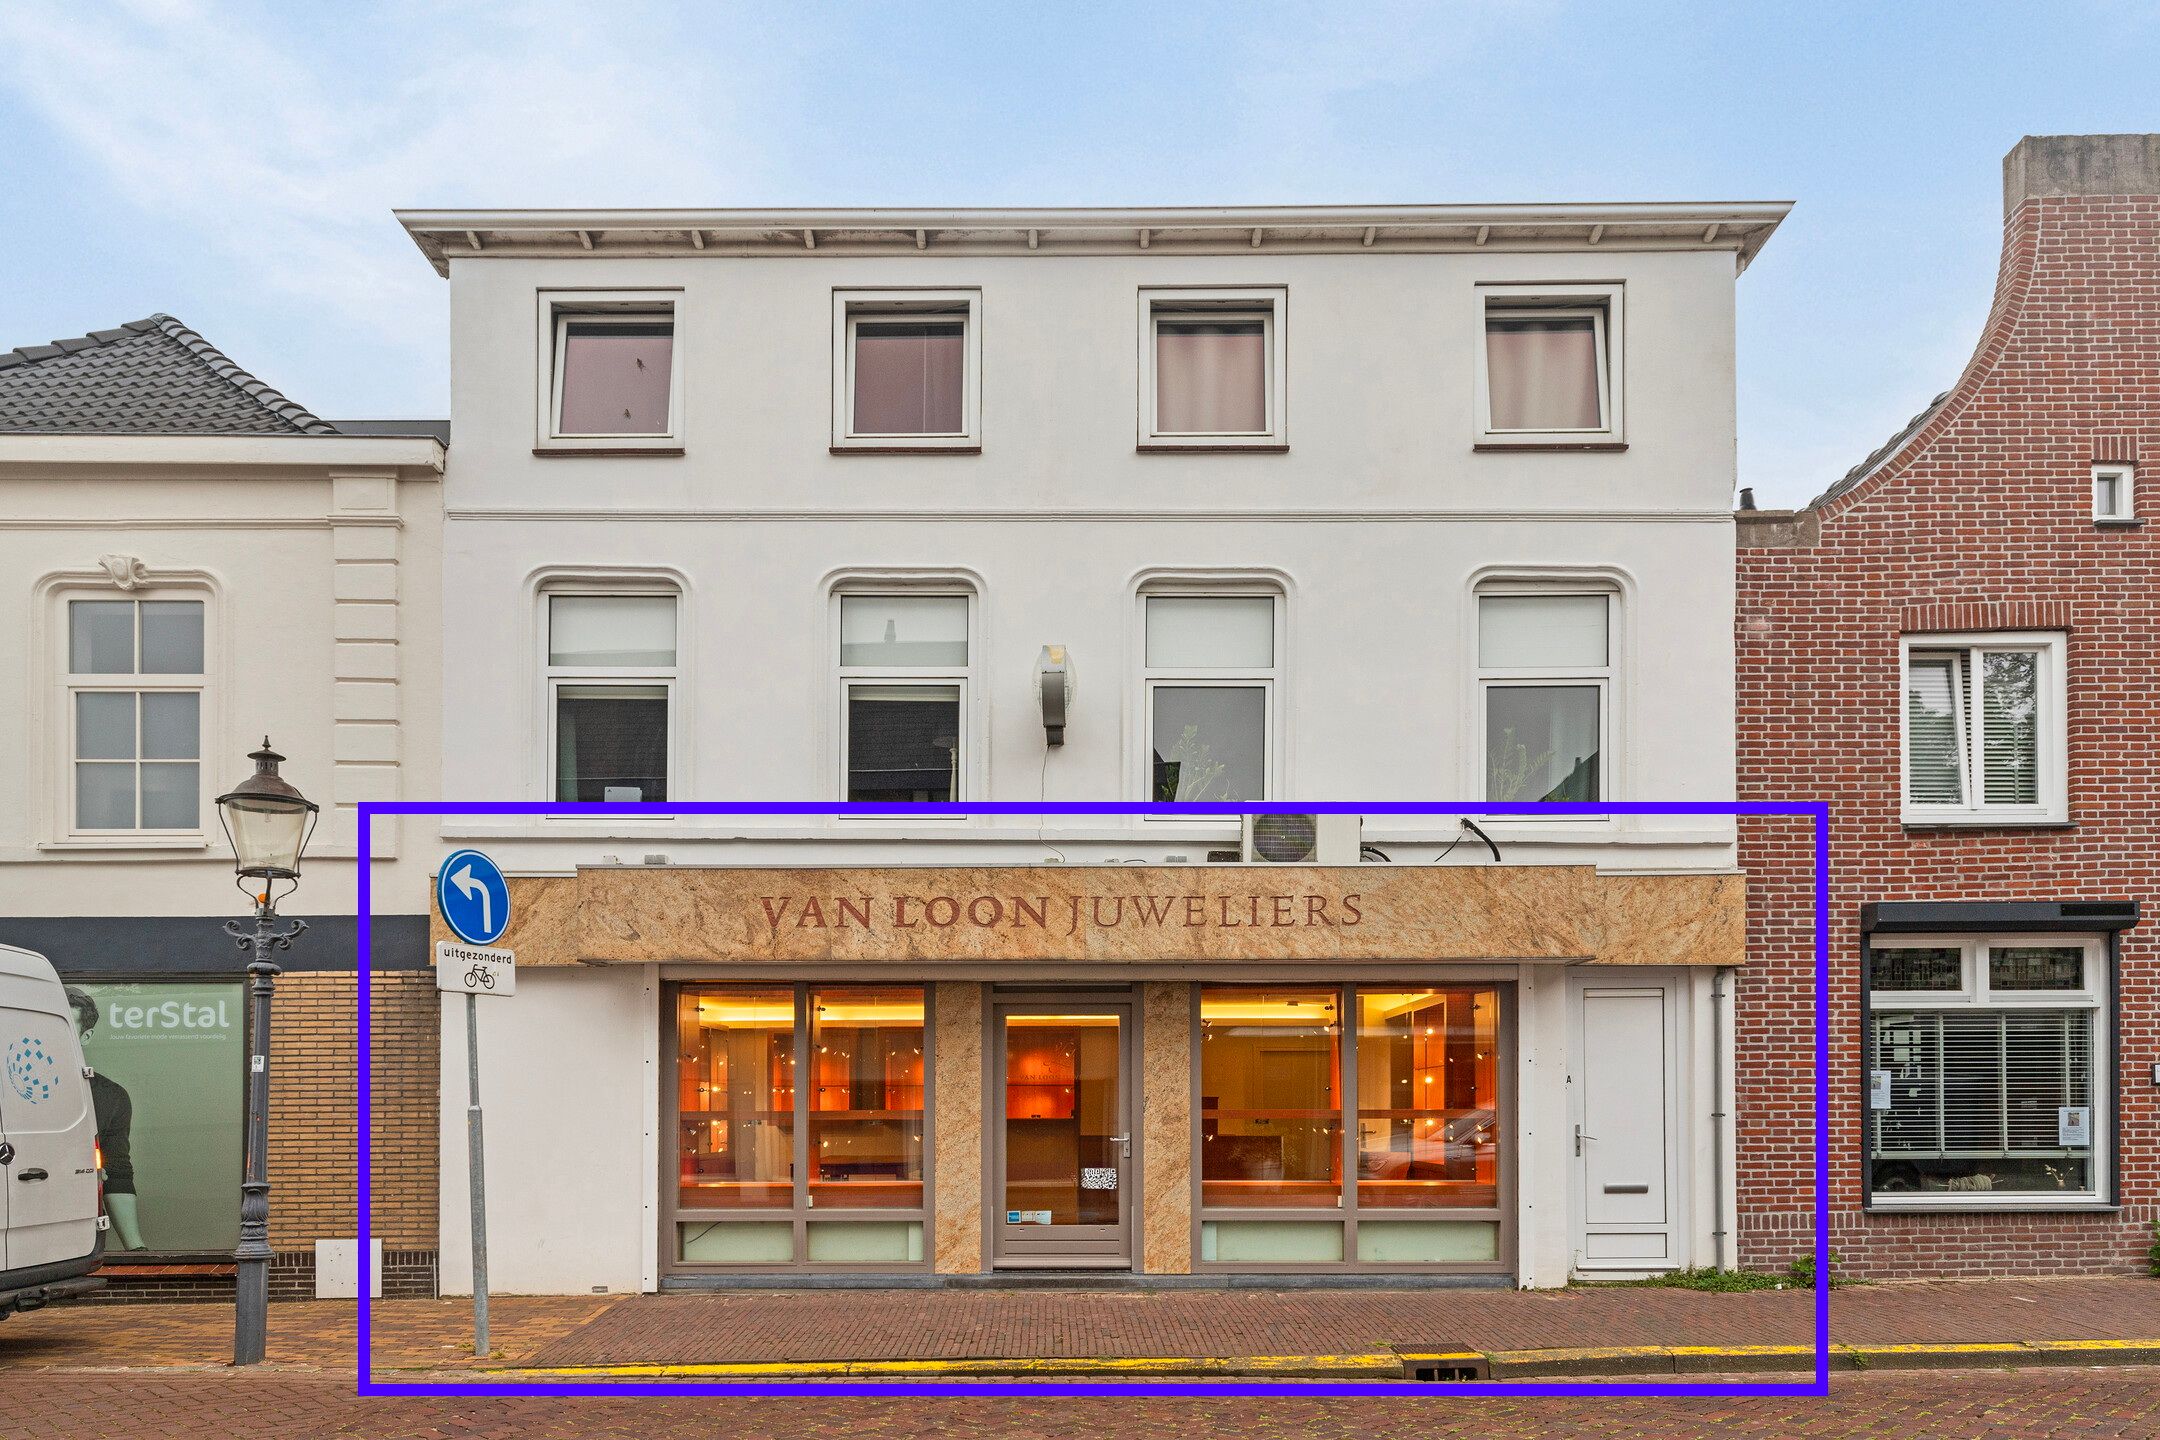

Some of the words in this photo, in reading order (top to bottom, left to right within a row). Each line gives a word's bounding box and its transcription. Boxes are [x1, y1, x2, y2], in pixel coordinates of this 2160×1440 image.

[760, 896, 874, 929] VAN
[893, 895, 1050, 929] LOON
[1065, 894, 1362, 936] JUWELIERS
[443, 947, 512, 965] uitgezonderd
[109, 1000, 230, 1028] terStal
[1566, 1075, 1572, 1083] A
